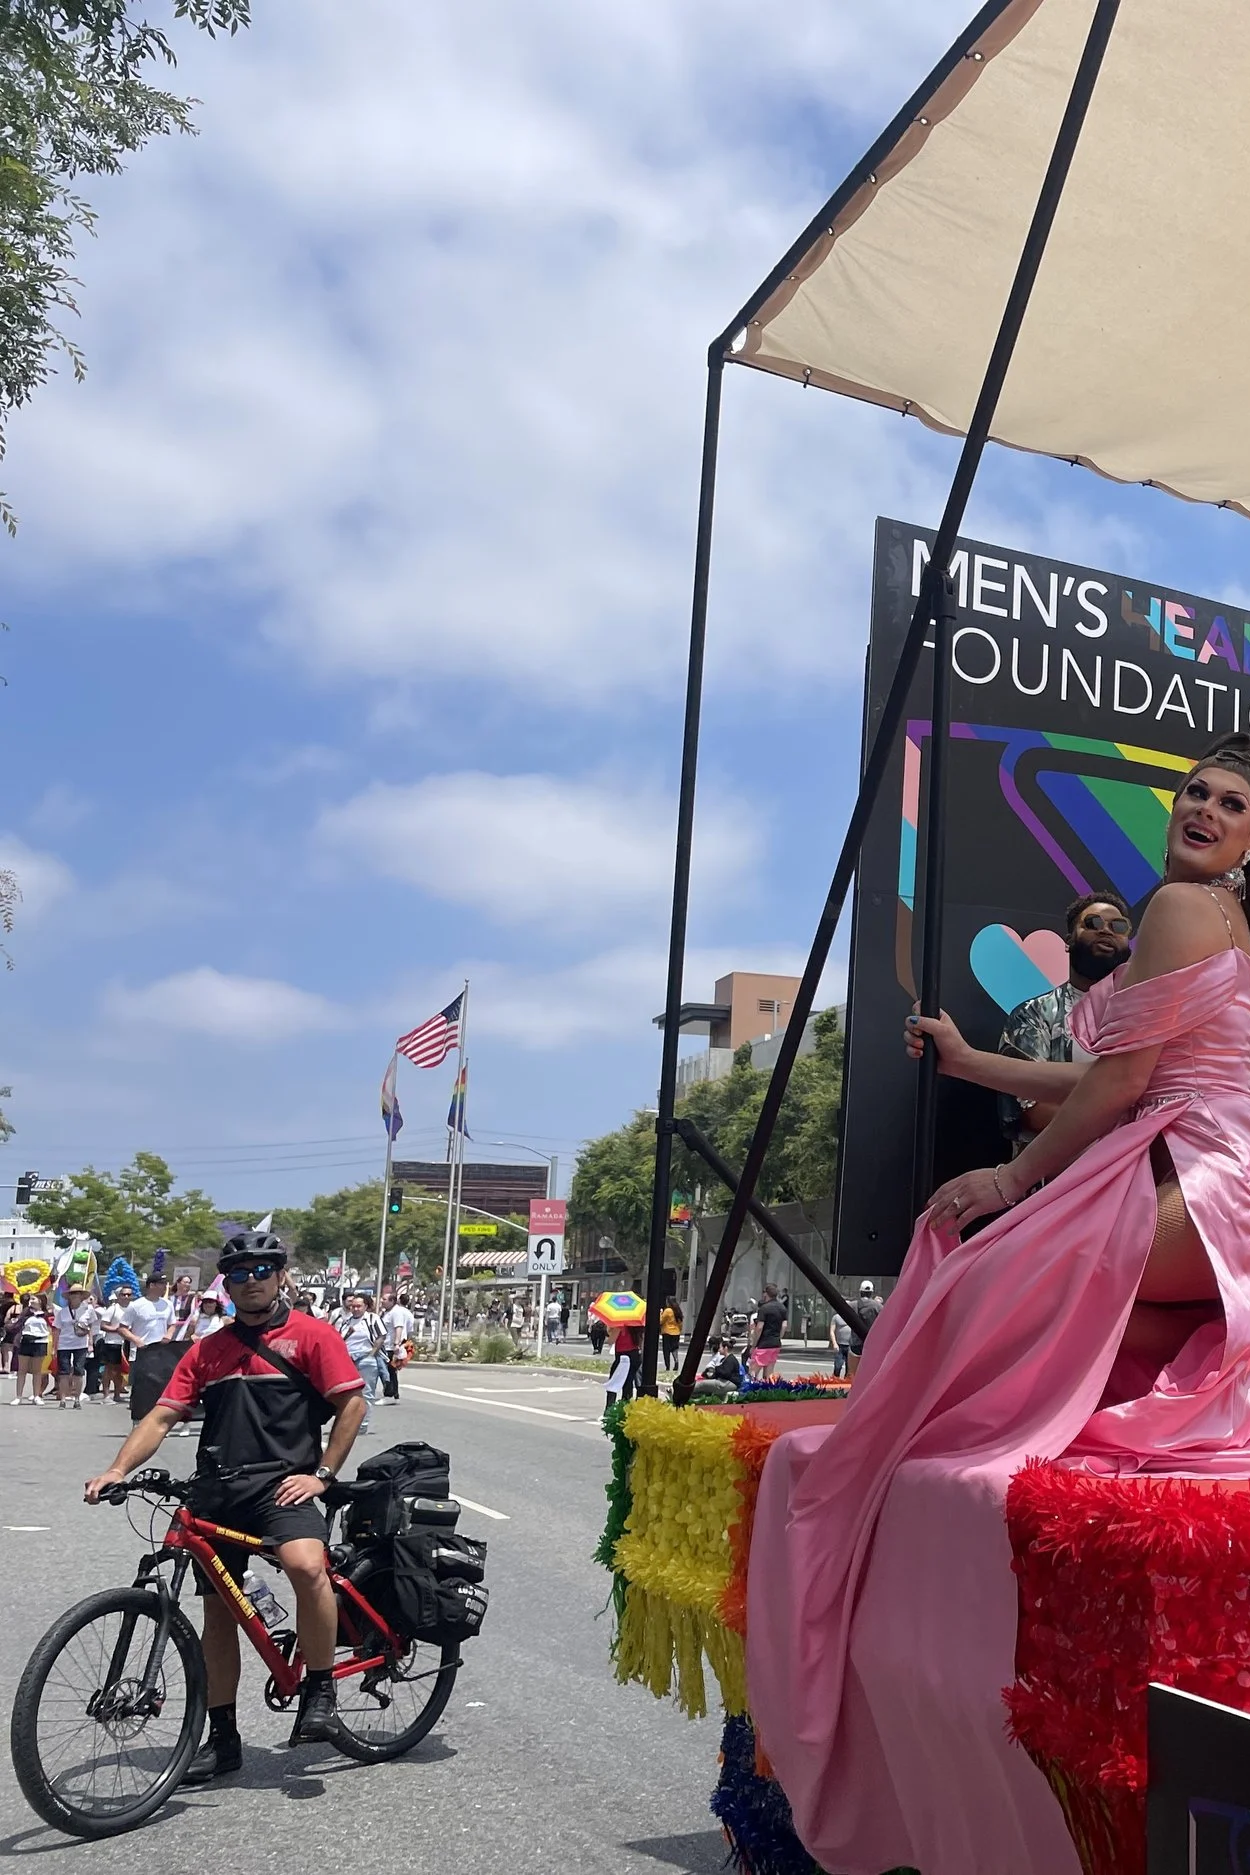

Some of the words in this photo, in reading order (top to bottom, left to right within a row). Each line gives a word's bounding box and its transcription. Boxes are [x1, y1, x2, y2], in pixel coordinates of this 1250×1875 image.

[911, 539, 1109, 638] MEN'S
[532, 1263, 557, 1271] ONLY
[210, 1554, 226, 1575] FIRE
[222, 1571, 256, 1620] DEPARTMENT
